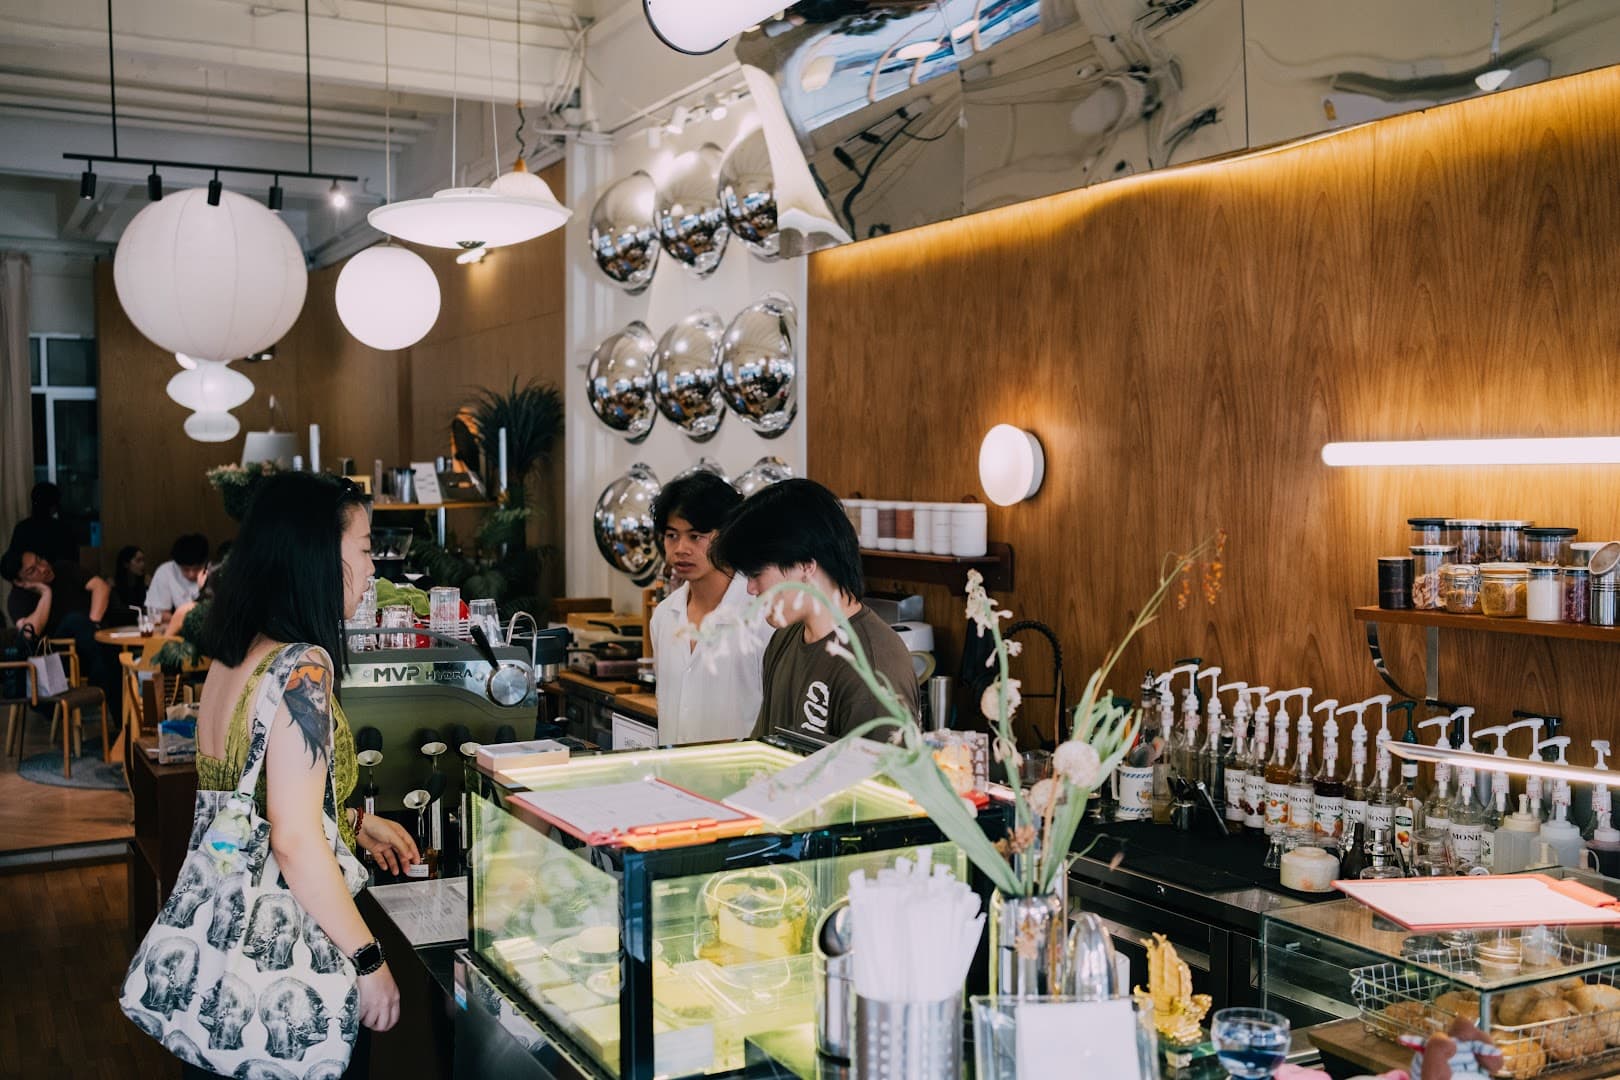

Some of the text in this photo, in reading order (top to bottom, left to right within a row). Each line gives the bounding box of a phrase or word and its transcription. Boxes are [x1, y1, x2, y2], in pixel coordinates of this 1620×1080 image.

[373, 665, 473, 683] MVP HYDRA
[1315, 802, 1343, 811] MONIN
